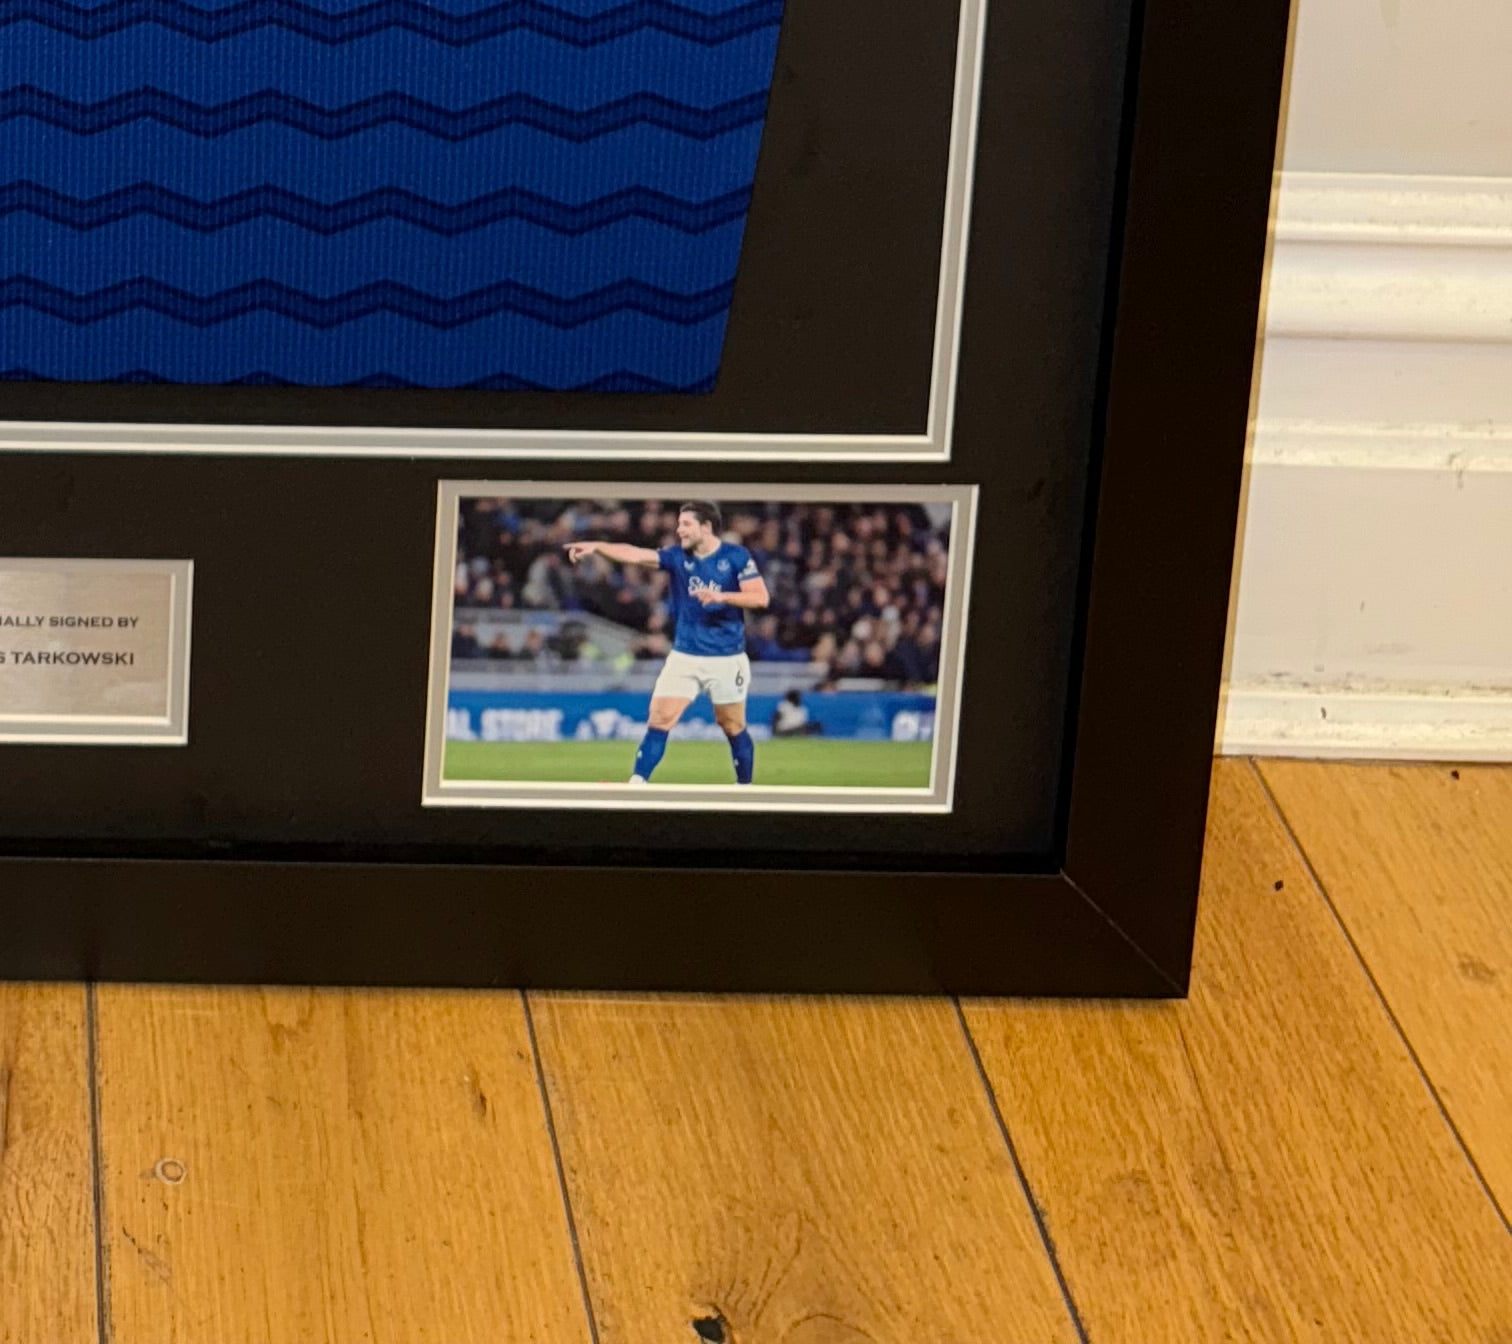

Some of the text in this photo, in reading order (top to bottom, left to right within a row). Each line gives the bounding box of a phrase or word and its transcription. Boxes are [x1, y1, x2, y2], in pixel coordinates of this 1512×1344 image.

[48, 616, 114, 628] SIGNED
[117, 616, 139, 628] BY
[10, 651, 135, 665] TARKOWSKI
[735, 670, 744, 687] 6
